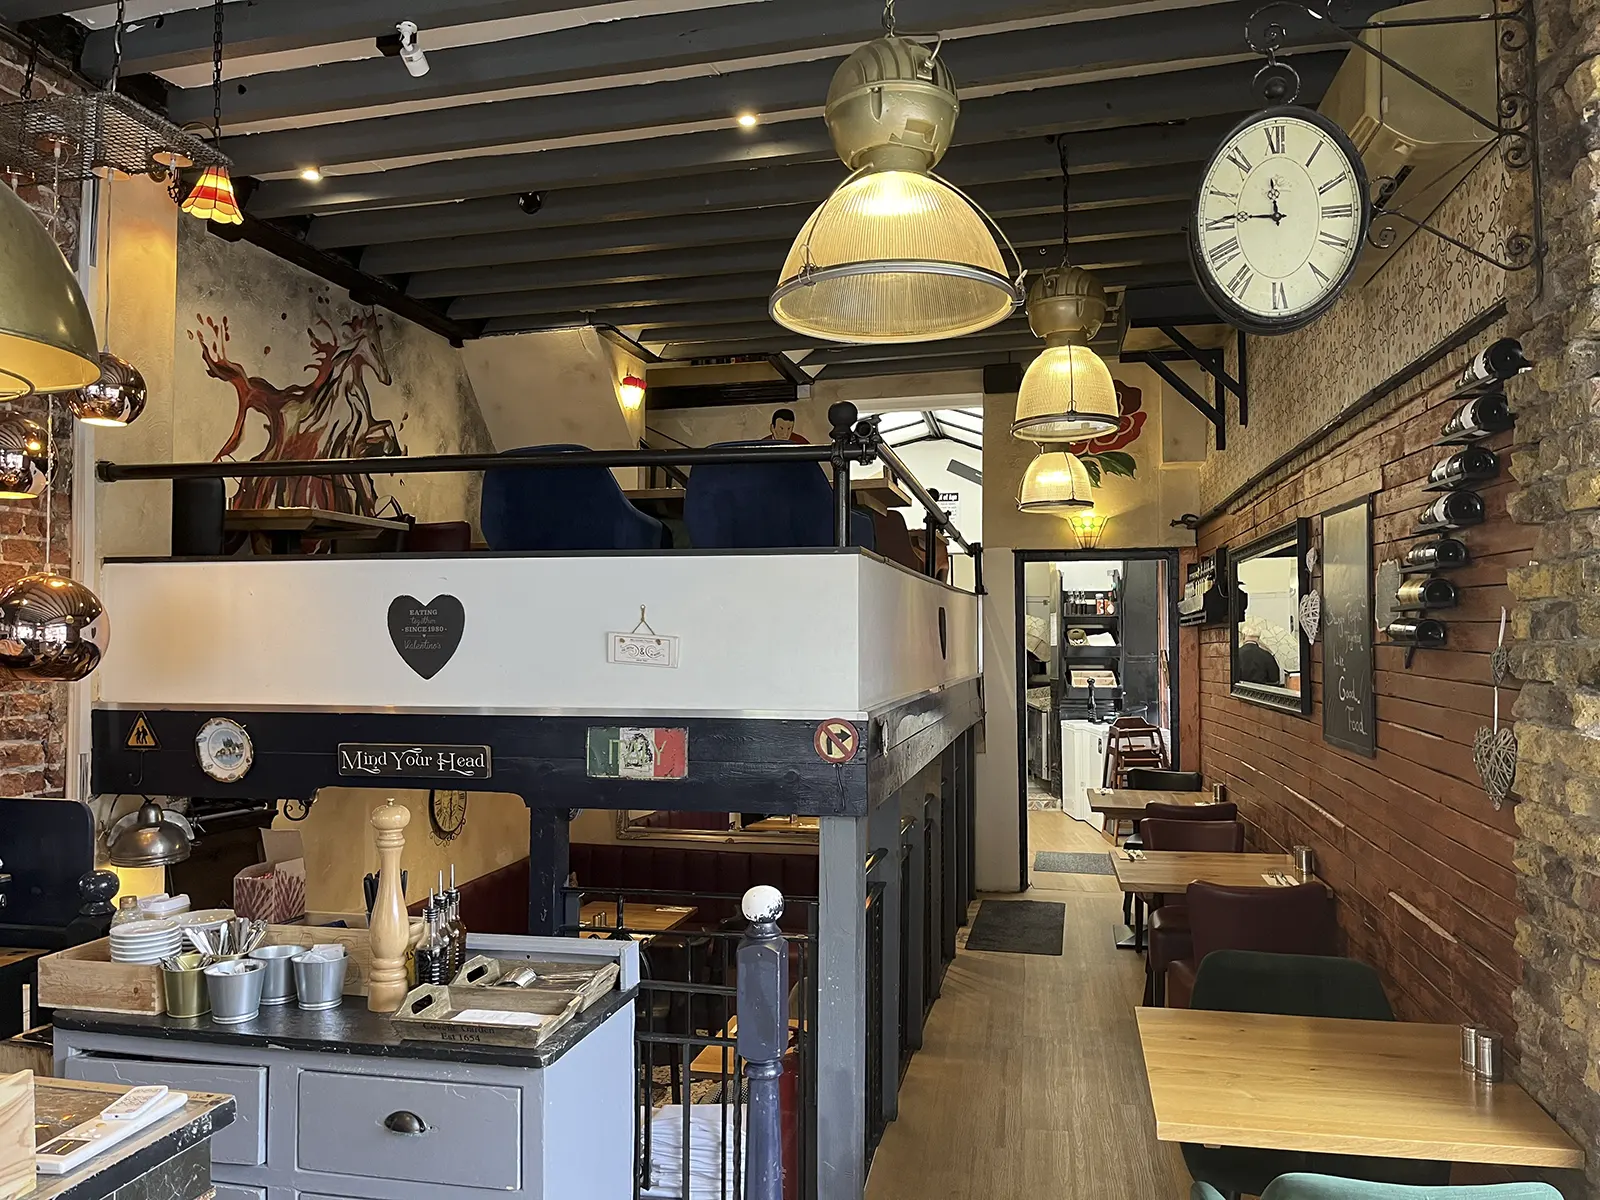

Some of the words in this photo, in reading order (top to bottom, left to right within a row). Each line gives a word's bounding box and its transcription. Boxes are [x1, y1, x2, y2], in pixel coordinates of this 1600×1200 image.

[404, 639, 442, 650] Valentino's
[341, 750, 388, 775] Mind
[390, 747, 433, 771] Your
[436, 752, 485, 776] Head
[459, 1034, 481, 1042] 1654
